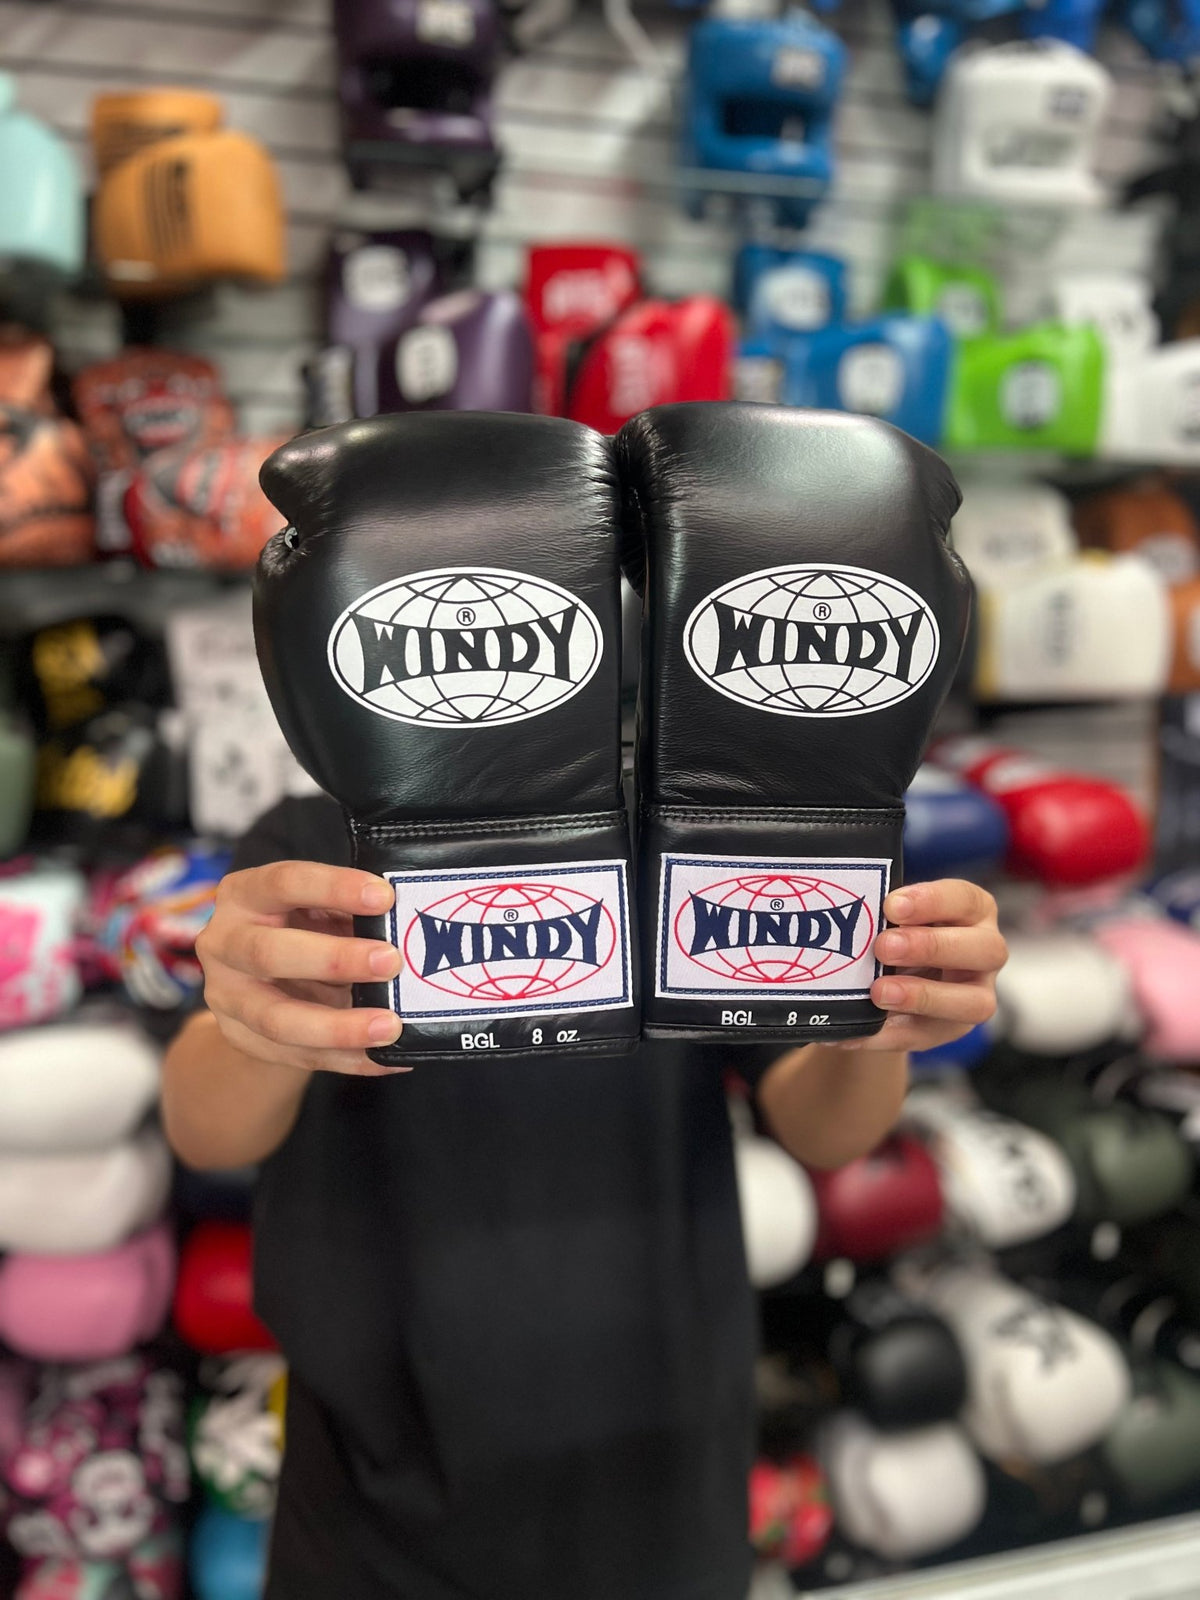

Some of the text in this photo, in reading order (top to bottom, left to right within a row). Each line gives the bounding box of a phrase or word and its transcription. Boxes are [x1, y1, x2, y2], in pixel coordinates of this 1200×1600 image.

[349, 603, 579, 695] WINDY
[709, 599, 926, 685] WINDY
[415, 898, 603, 977] WINDY
[688, 890, 866, 959] WINDY
[461, 1033, 501, 1050] BGL
[532, 1029, 543, 1045] 8
[721, 1010, 756, 1026] BGL
[786, 1011, 797, 1026] 8
